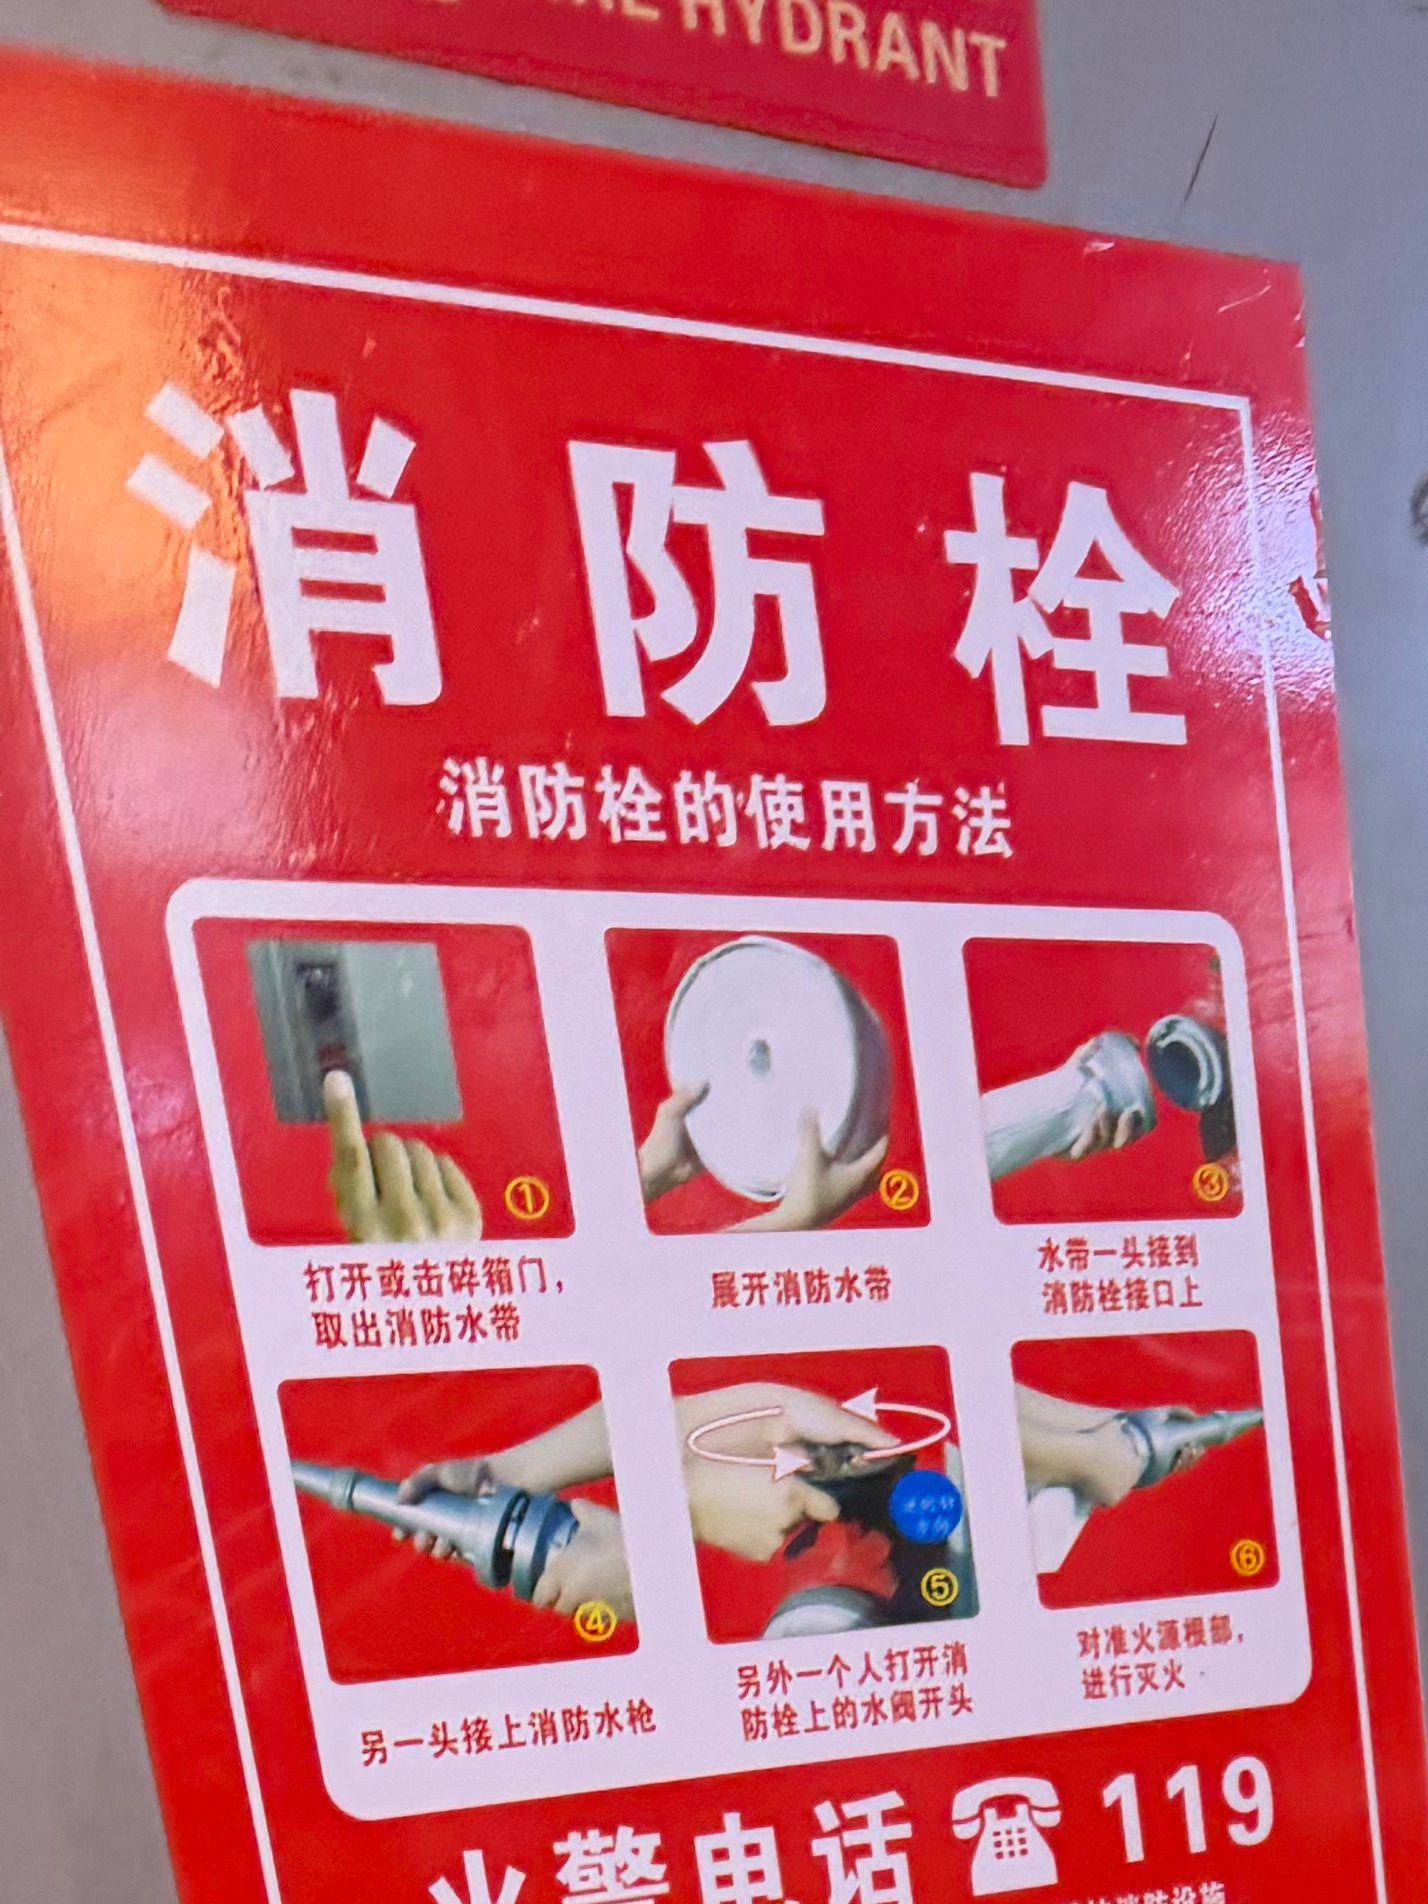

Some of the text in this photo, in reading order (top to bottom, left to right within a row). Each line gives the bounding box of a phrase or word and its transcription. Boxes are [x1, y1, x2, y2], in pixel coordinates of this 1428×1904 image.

[126, 381, 1188, 747] 消防栓
[436, 756, 1015, 860] 消防栓的使用方法
[1038, 1233, 1199, 1272] 水带一头接到
[711, 1265, 892, 1308] 展开消防水带
[1043, 1276, 1203, 1315] 消防栓接口上
[312, 1302, 520, 1350] 取出消防水带
[737, 1642, 968, 1701] 另外一个人打开消
[1082, 1660, 1185, 1700] 进行灭火
[361, 1697, 656, 1767] 另一头接上消防水枪
[741, 1682, 973, 1741] 防栓上的水阀开头
[1102, 1754, 1275, 1864] 119
